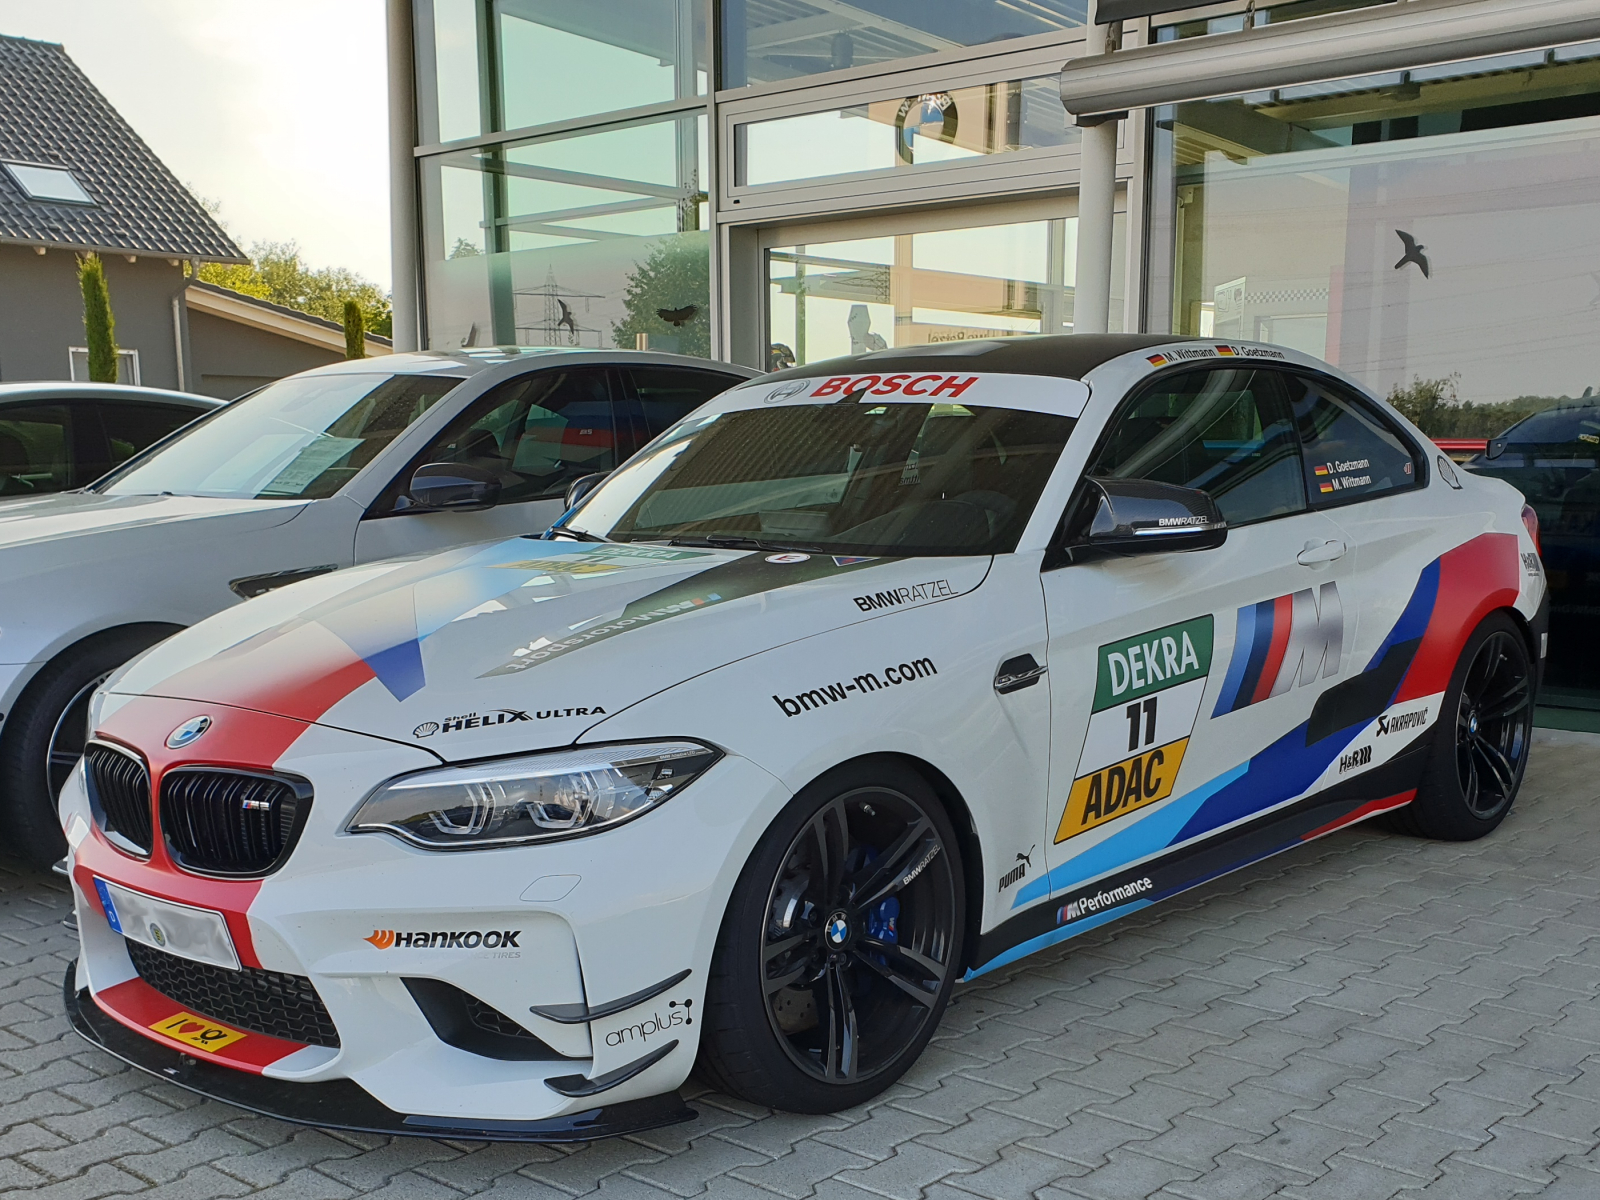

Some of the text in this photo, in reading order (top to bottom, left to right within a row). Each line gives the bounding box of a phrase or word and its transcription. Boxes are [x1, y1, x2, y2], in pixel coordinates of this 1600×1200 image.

[1175, 348, 1217, 360] Wittmann
[1230, 346, 1243, 357] D.
[1242, 346, 1286, 360] Goetzmann
[809, 374, 979, 397] BOSCH
[1326, 458, 1370, 474] D. Goetzmann
[1331, 475, 1372, 491] M. Wittmann
[1107, 630, 1200, 697] DEKRA
[772, 657, 938, 717] bmw-m.com
[442, 706, 607, 733] HELIX ULTRA
[443, 712, 477, 722] Shell
[1126, 696, 1158, 752] 11
[1081, 749, 1164, 826] ADAC
[999, 863, 1026, 893] PUMA
[1078, 877, 1153, 914] Performance
[491, 951, 521, 960] TIRES
[605, 1011, 684, 1047] amplus
